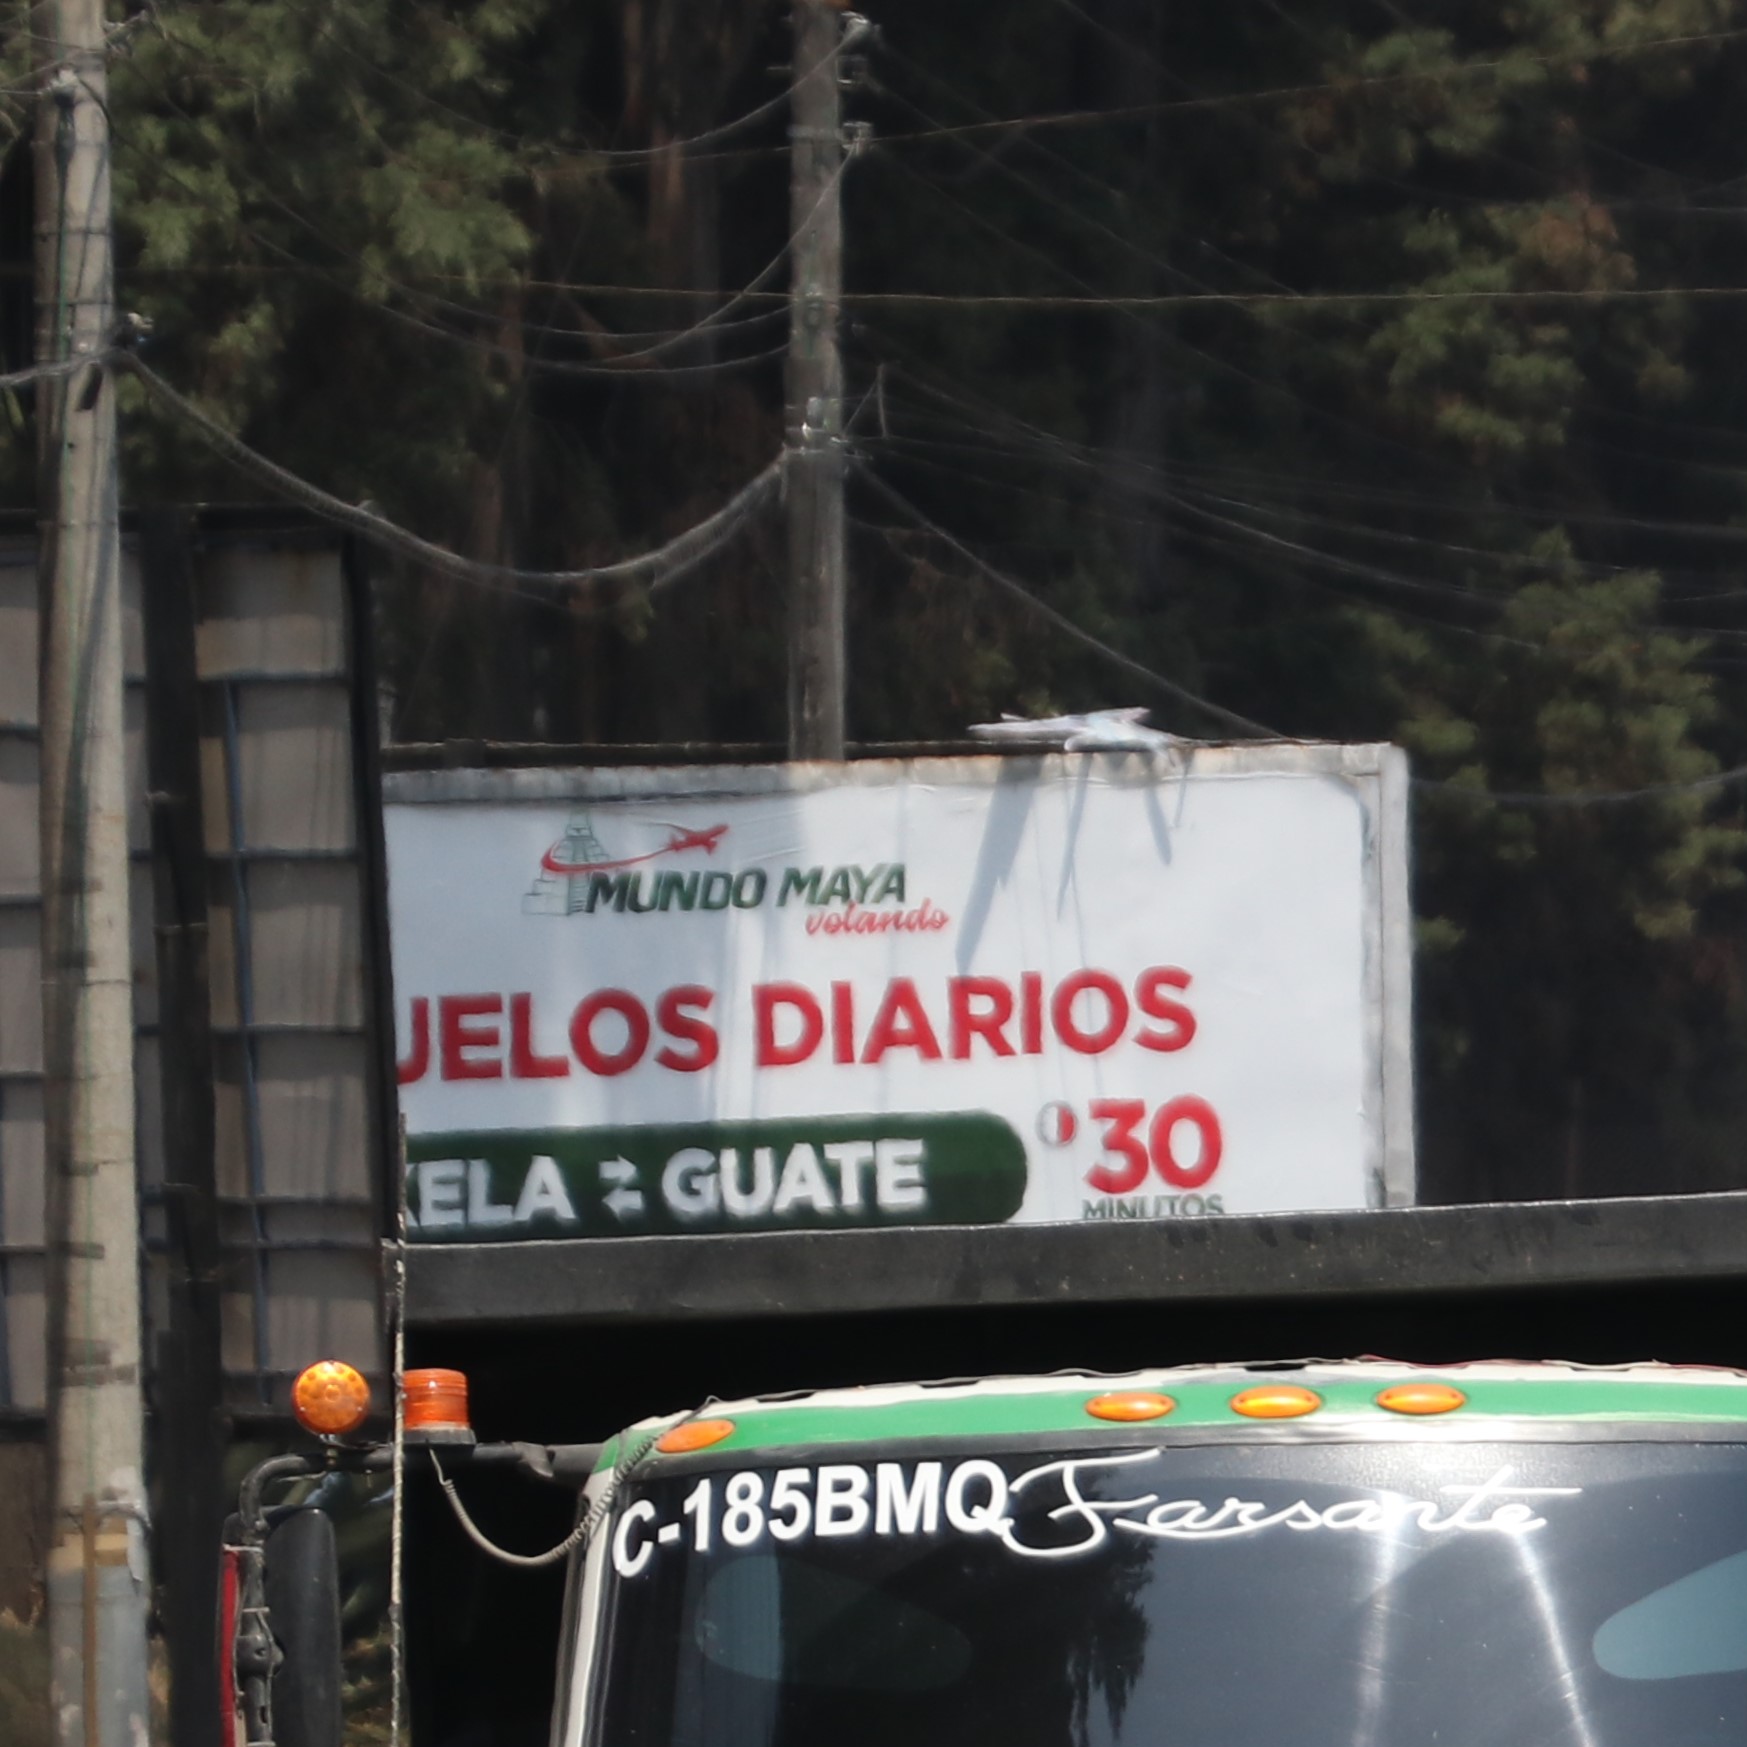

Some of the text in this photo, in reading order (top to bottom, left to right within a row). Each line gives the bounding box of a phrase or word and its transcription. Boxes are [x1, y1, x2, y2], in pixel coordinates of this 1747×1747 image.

[583, 862, 908, 914] MUNDO MAYA
[804, 896, 950, 938] volando
[752, 963, 1199, 1071] DIARIOS
[405, 1136, 926, 1231] ELA GUATE
[1083, 1093, 1223, 1195] 30
[1081, 1192, 1225, 1221] MINUTOS
[611, 1445, 1583, 1578] C-185BMQ Farsante
